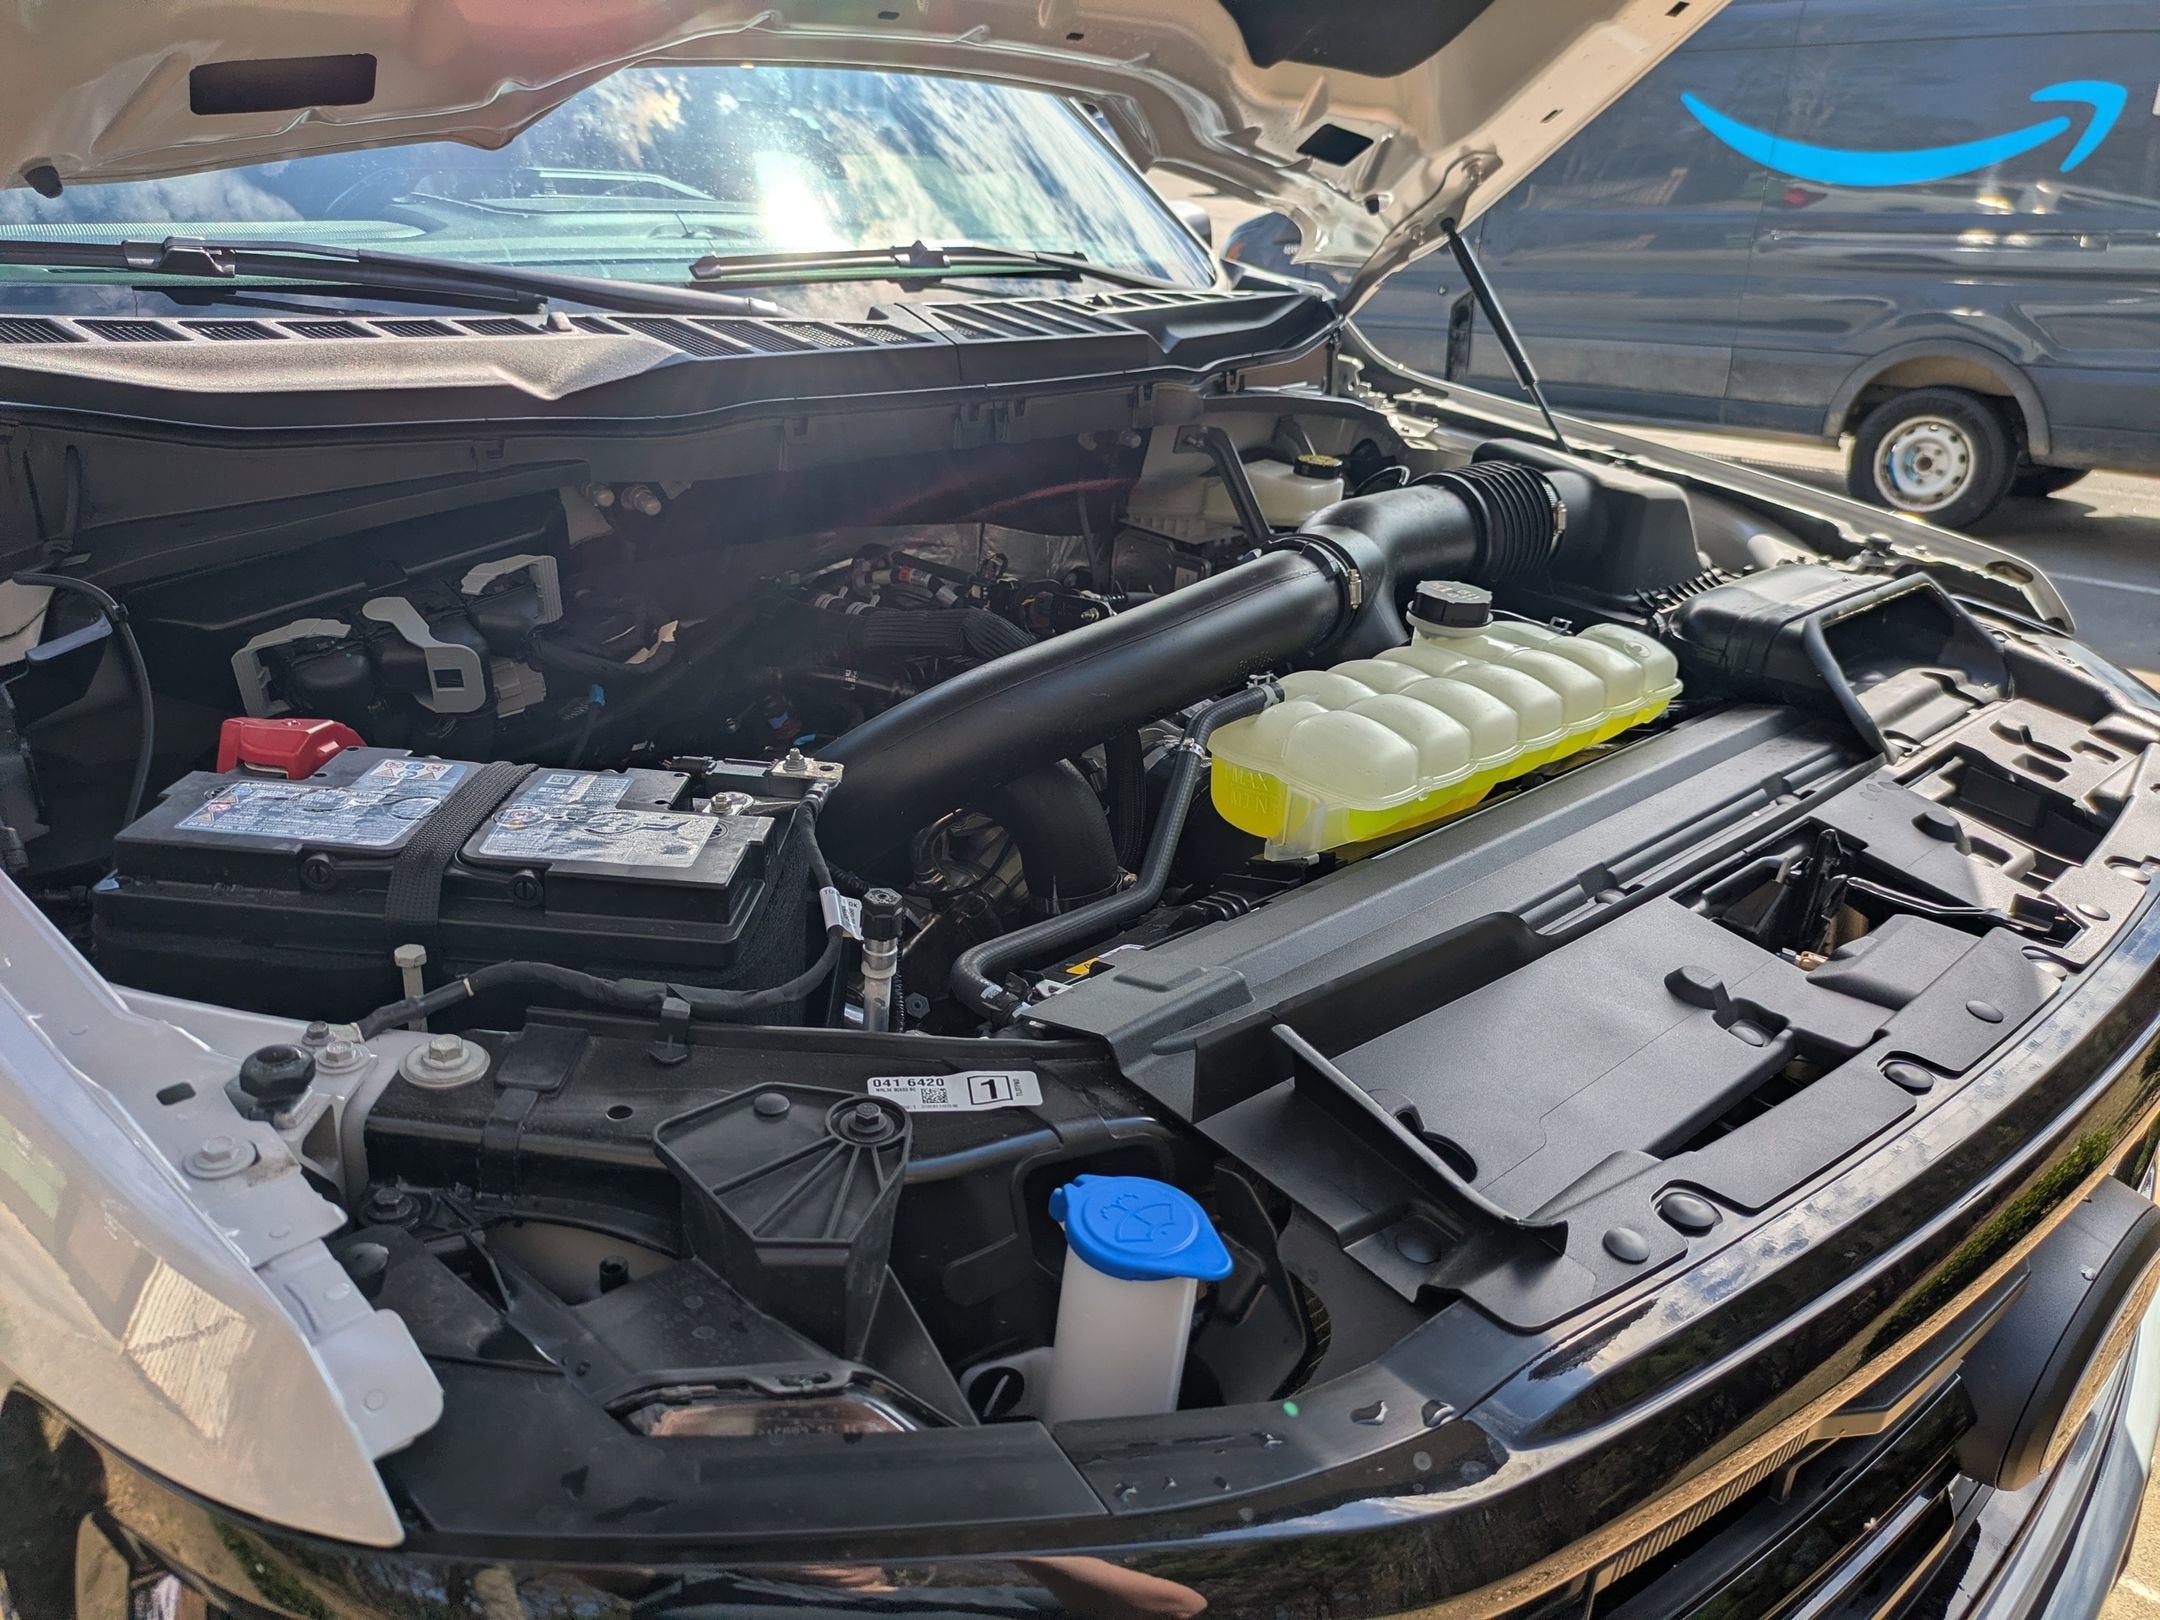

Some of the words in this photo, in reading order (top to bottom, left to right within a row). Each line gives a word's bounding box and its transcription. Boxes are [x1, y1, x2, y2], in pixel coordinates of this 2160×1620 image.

[1231, 767, 1269, 792] MAX
[1230, 791, 1268, 815] MIN
[873, 1079, 900, 1088] 041
[907, 1078, 945, 1087] 6420
[980, 1078, 998, 1100] 1
